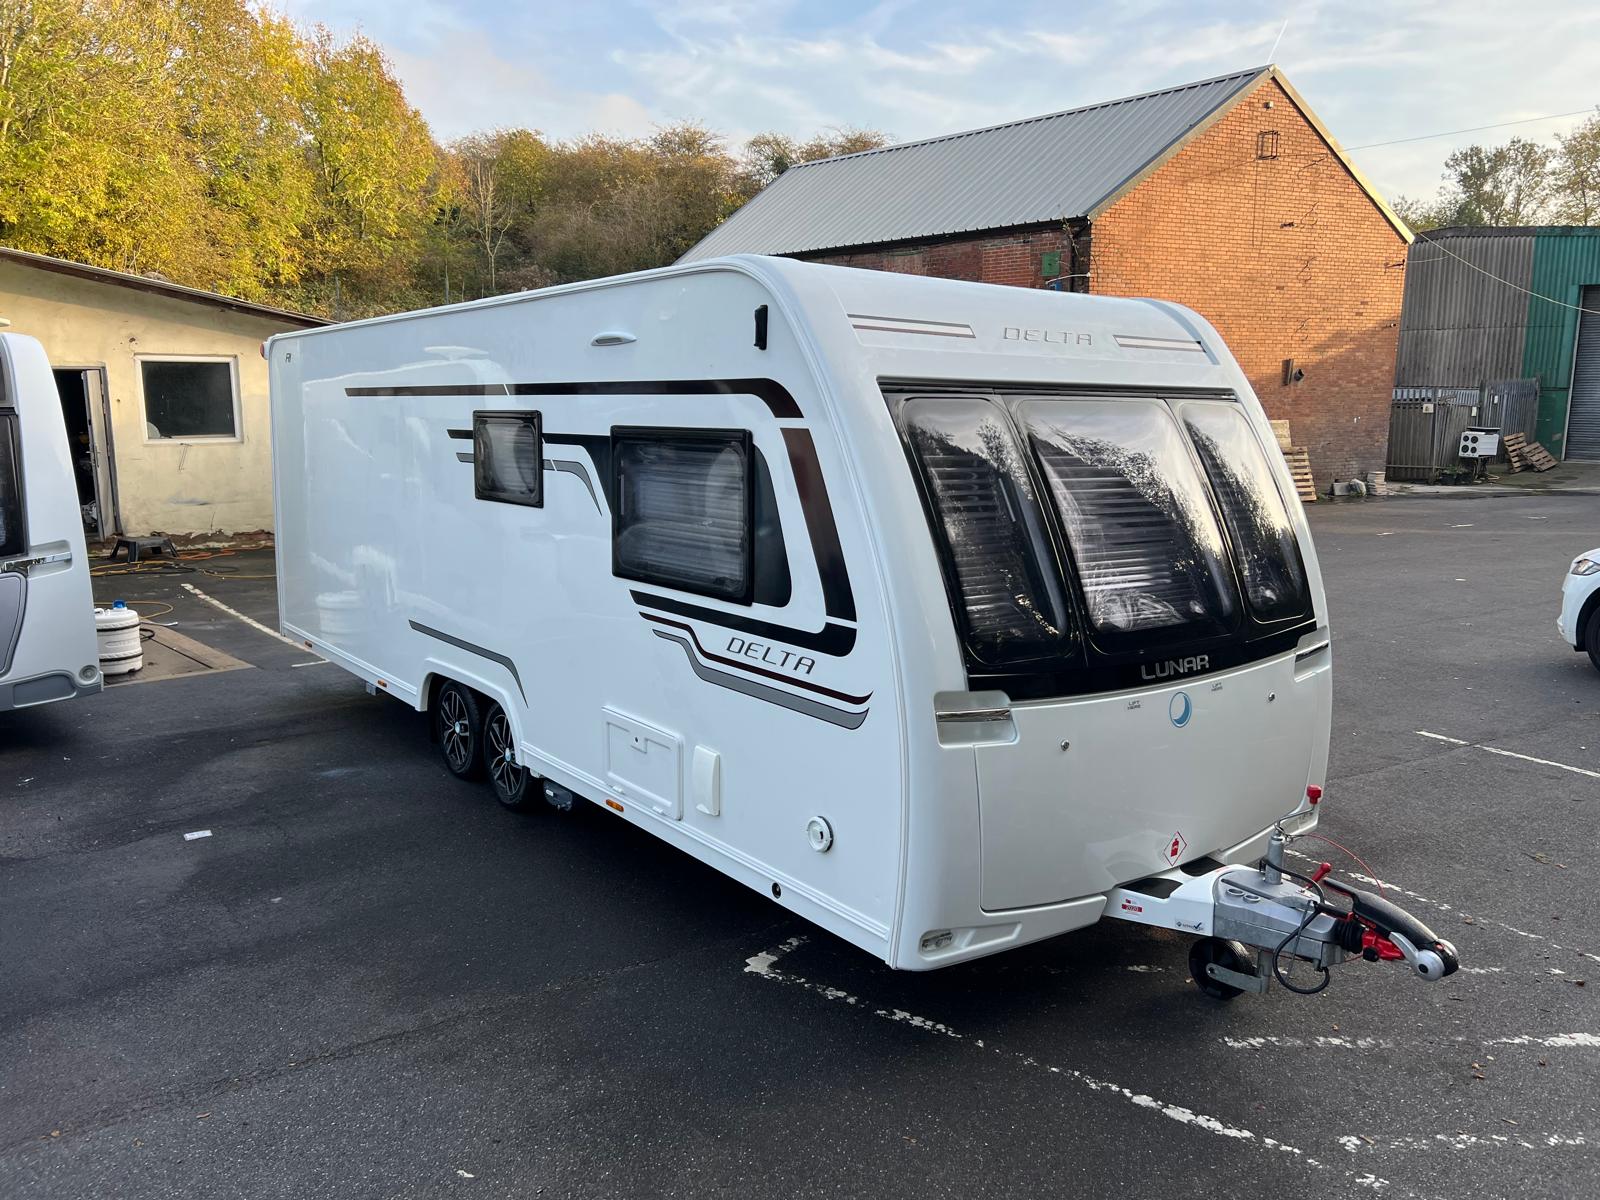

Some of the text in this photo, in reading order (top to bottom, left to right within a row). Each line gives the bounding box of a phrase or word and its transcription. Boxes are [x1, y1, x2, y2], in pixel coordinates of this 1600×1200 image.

[1003, 327, 1092, 346] DELTA
[726, 637, 816, 675] DELTA
[1141, 654, 1210, 680] LUNAR
